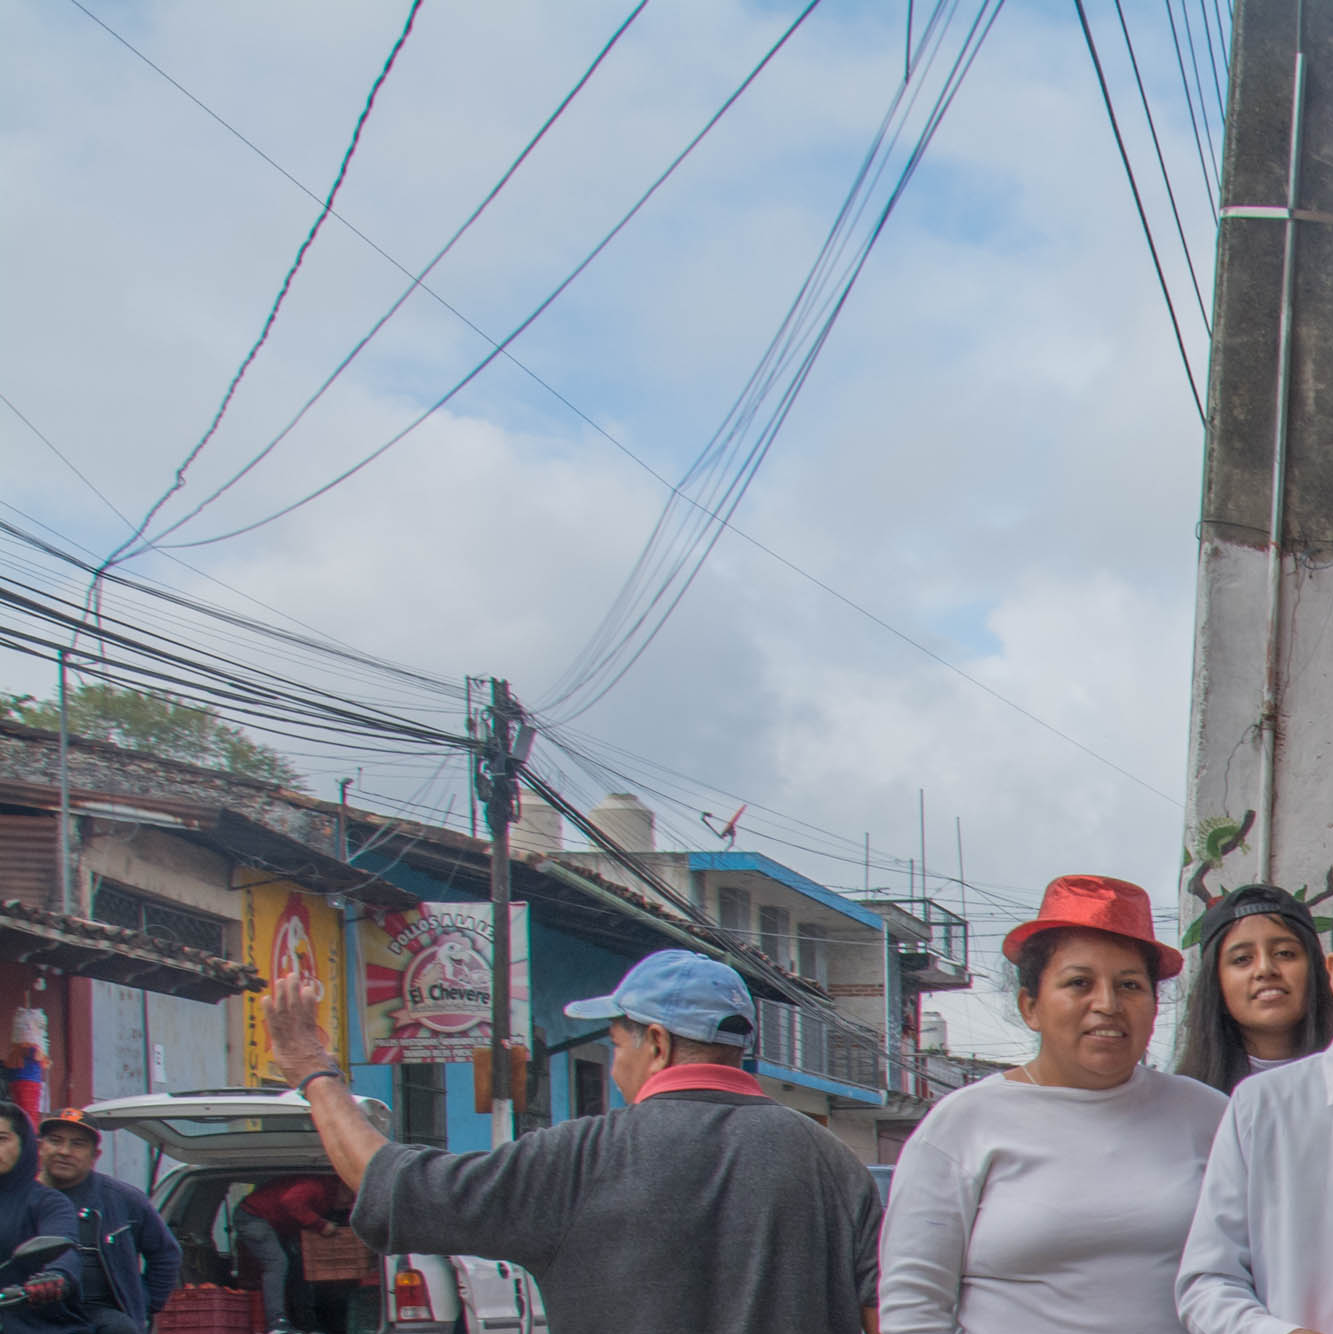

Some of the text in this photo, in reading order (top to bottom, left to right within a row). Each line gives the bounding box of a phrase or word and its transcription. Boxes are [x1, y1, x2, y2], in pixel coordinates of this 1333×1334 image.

[387, 914, 440, 956] POLLOS
[441, 912, 455, 928] A
[429, 982, 490, 1005] Chevere
